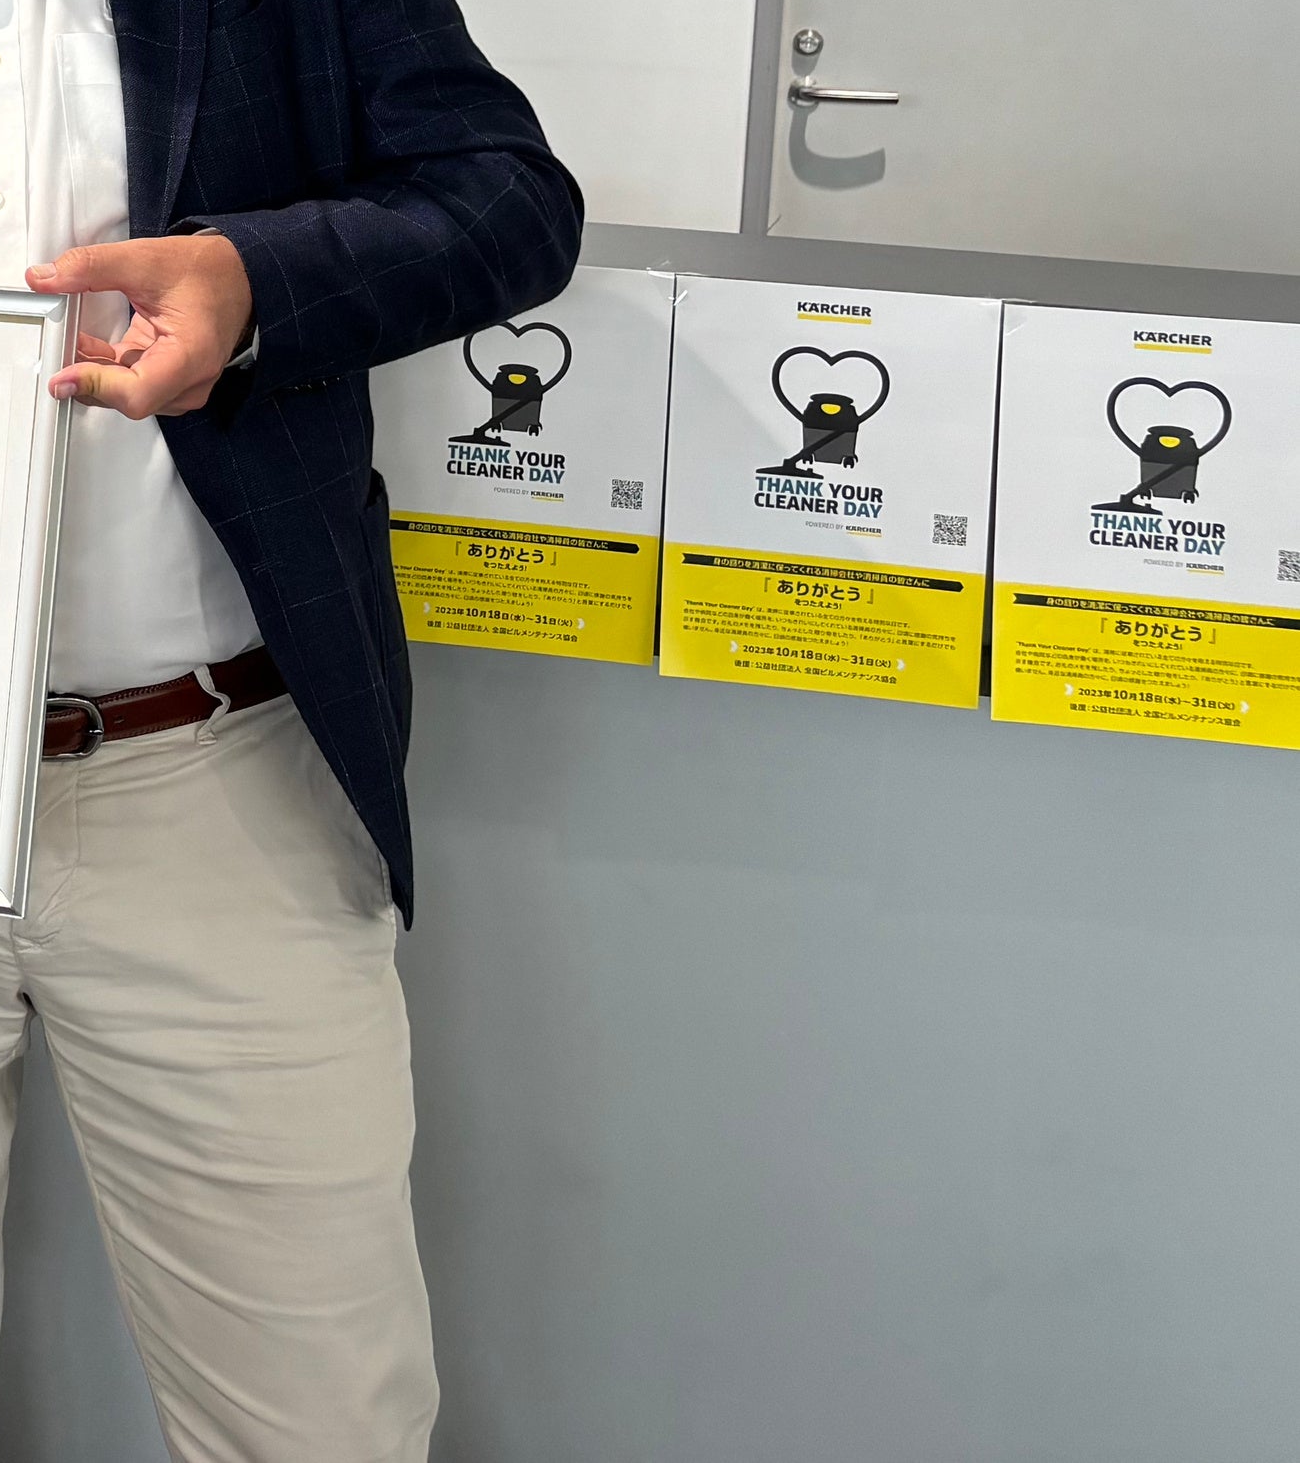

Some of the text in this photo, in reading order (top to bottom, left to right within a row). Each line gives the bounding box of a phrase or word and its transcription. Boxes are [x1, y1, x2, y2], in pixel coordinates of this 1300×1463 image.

[797, 301, 871, 318] KÄRCHER
[1134, 330, 1212, 347] KÄRCHER
[448, 445, 565, 469] THANK YOUR
[447, 461, 565, 484] CLEANER DAY
[755, 476, 883, 503] THANK YOUR
[754, 493, 882, 518] CLEANER DAY
[1091, 513, 1226, 539] THANK YOUR
[1090, 530, 1225, 555] CLEANER DAY
